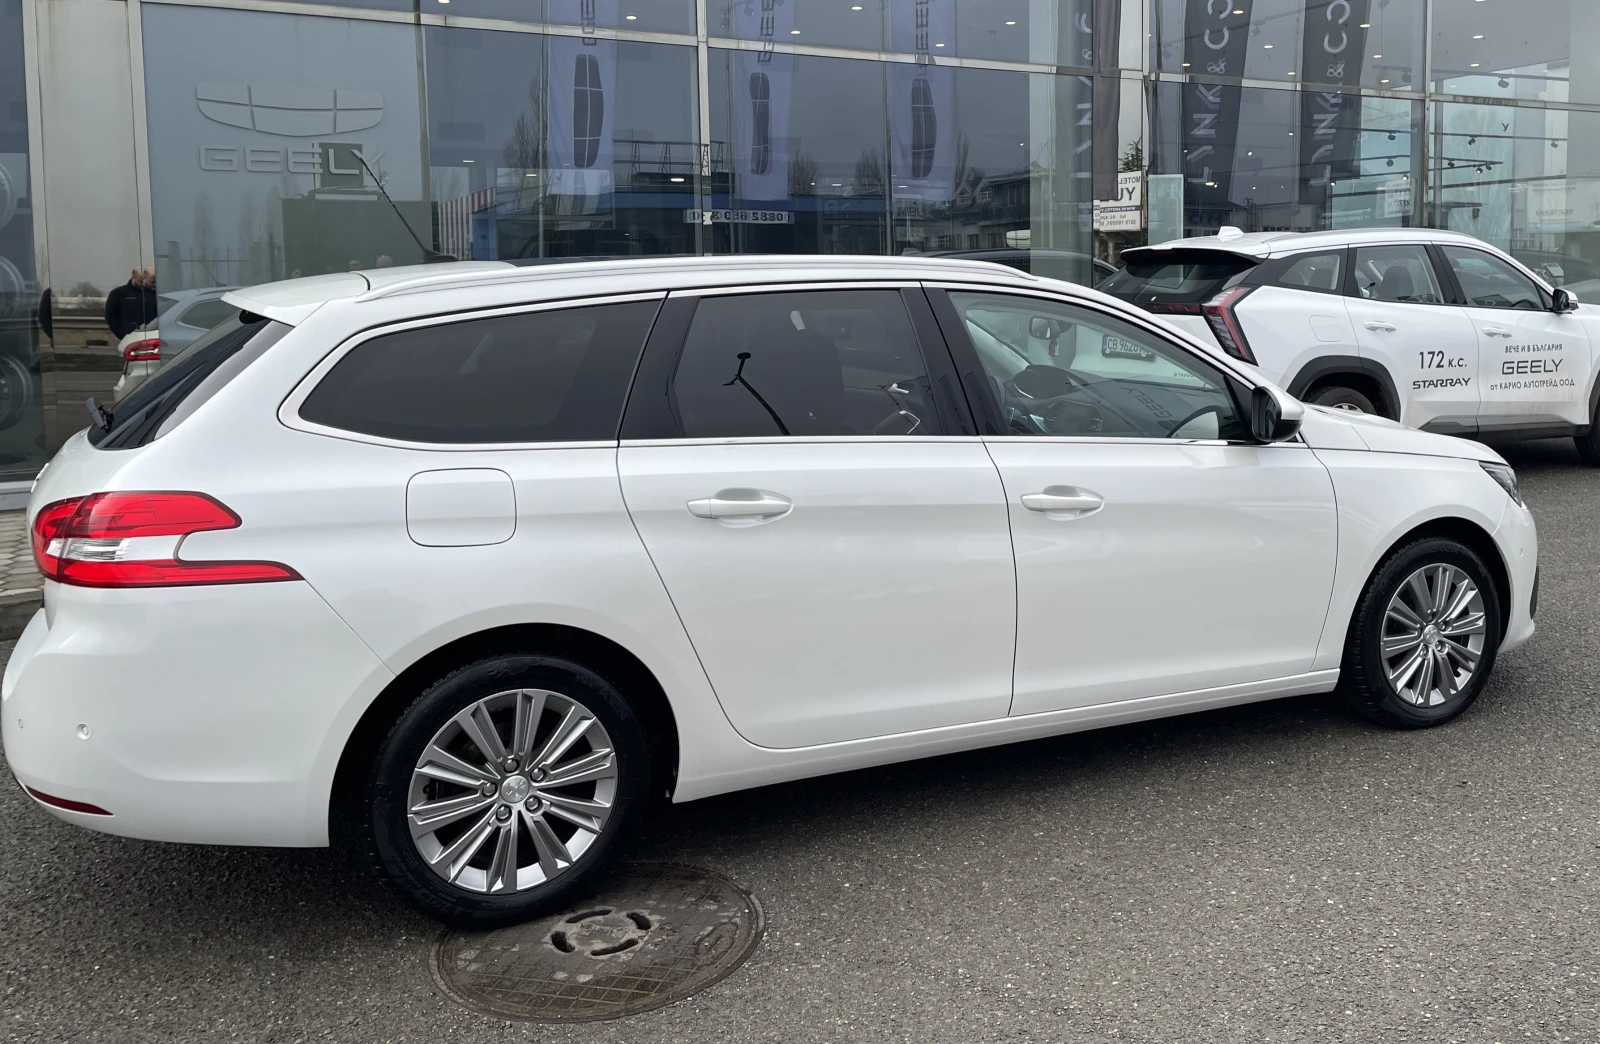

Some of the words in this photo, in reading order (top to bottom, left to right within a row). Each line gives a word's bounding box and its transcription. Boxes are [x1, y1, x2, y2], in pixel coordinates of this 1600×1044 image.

[199, 146, 386, 175] GEELY
[1505, 345, 1519, 353] ВЕЧЕ
[1521, 344, 1526, 352] И
[1527, 344, 1531, 352] В
[1532, 343, 1563, 352] БЪЛГАРИЯ
[1419, 350, 1445, 369] 172
[1502, 358, 1563, 375] GEELY
[1412, 377, 1471, 390] STARRAY
[1499, 381, 1522, 390] КАРИО
[1523, 379, 1559, 389] АУТОТРЕЙД
[1559, 378, 1575, 387] ООД
[1121, 387, 1173, 418] GEELY
